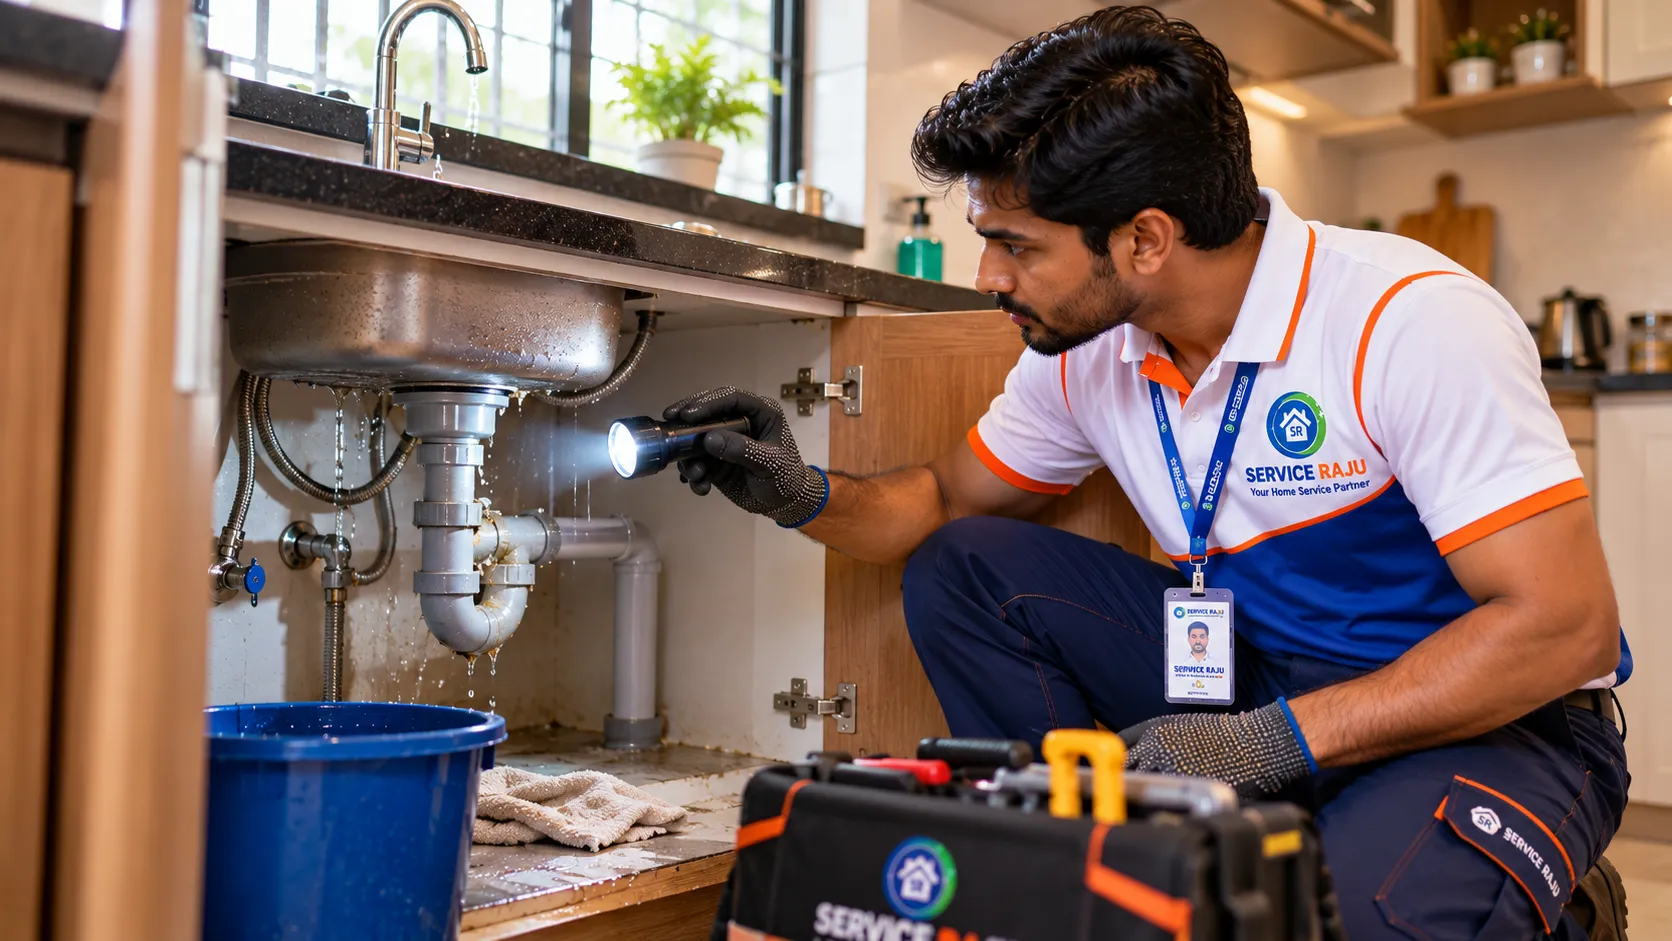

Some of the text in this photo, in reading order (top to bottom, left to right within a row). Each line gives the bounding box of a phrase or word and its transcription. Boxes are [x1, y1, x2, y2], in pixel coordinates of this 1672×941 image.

[1290, 425, 1303, 437] SR
[1245, 464, 1315, 482] SERVICE
[1318, 459, 1366, 479] RAJU
[1250, 480, 1370, 497] Your Home Service Partner
[1478, 816, 1492, 829] SR
[1503, 827, 1560, 897] SERVICE RAJU
[813, 901, 935, 941] SERVICE
